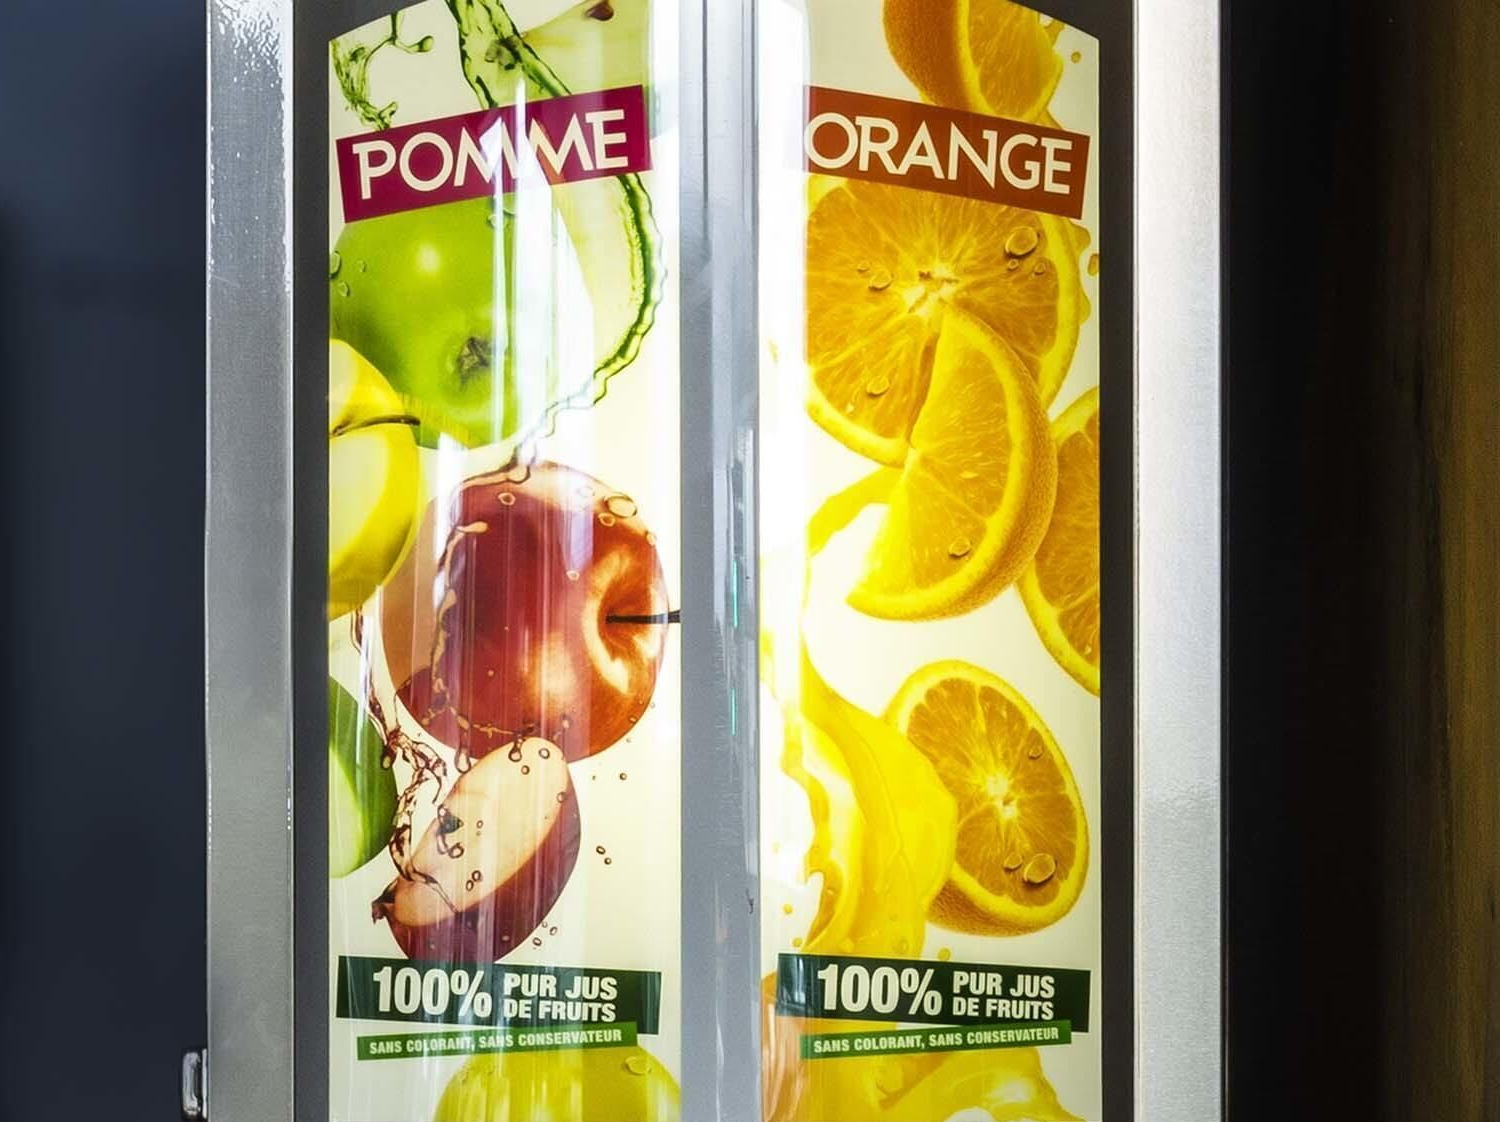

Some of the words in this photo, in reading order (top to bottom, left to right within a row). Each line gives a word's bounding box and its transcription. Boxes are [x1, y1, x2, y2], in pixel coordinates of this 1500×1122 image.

[353, 109, 629, 200] POMME
[804, 111, 1073, 195] ORANGE
[373, 966, 493, 1018] 100%
[503, 973, 557, 998] PUR
[565, 976, 617, 1001] JUS
[817, 964, 942, 1016] 100%
[953, 971, 1002, 995] PUR
[1010, 974, 1055, 999] JUS
[503, 998, 532, 1019] DE
[539, 1000, 616, 1022] FRUITS
[953, 997, 979, 1017] DE
[986, 998, 1054, 1020] FRUITS
[369, 1041, 402, 1055] SANS
[405, 1036, 476, 1053] COLORANT,
[479, 1034, 514, 1049] SANS
[518, 1029, 622, 1047] CONSERVATEUR
[813, 1039, 850, 1053] SANS
[854, 1035, 925, 1051] COLORANT,
[929, 1032, 963, 1048] SANS
[967, 1027, 1059, 1045] CONSERVATEUR
